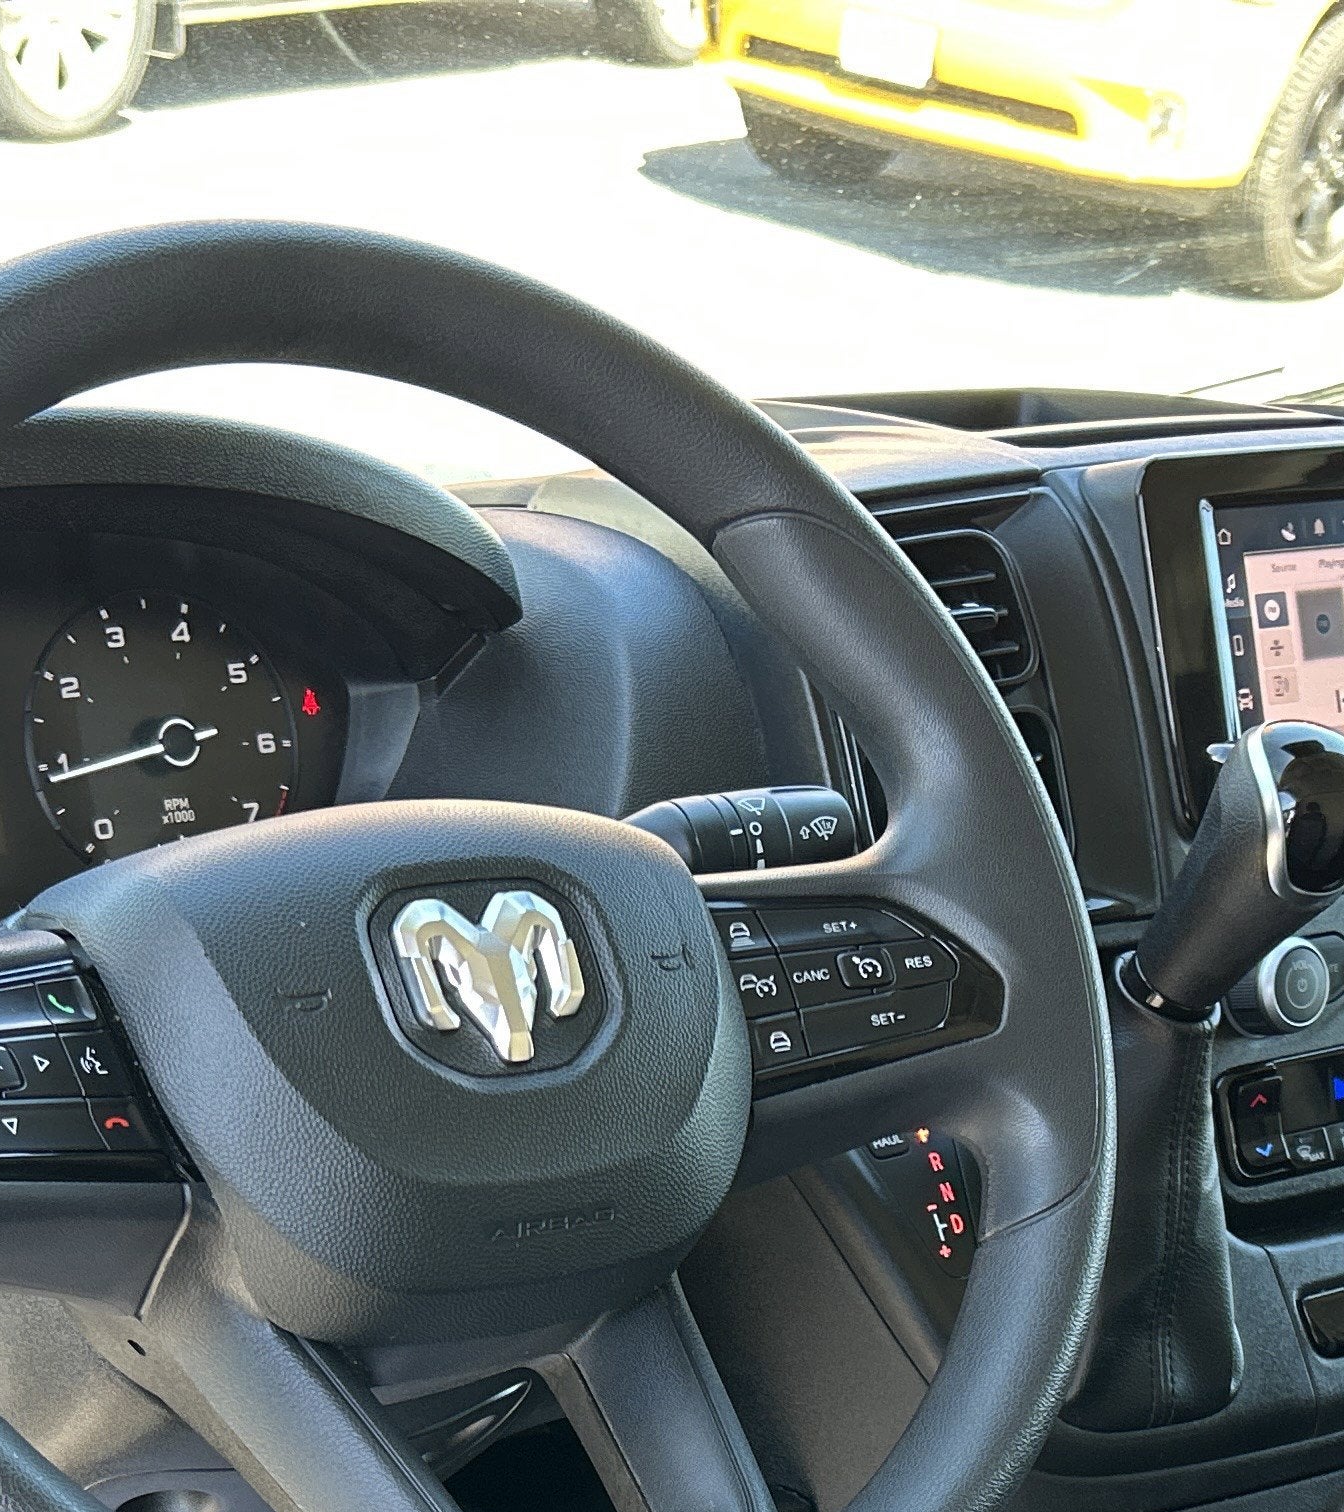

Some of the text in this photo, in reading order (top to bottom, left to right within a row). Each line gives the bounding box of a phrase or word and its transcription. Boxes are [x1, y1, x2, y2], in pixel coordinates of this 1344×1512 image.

[106, 626, 126, 648] 3
[171, 622, 190, 643] 4
[227, 662, 247, 684] 5
[59, 677, 80, 699] 2
[257, 733, 276, 754] 6
[57, 753, 69, 773] 1
[163, 797, 190, 811] RPM
[242, 802, 260, 823] 7
[162, 809, 195, 825] x1000
[94, 818, 114, 839] 0
[823, 920, 858, 935] SET+
[904, 954, 933, 970] RES
[792, 967, 831, 985] CANC
[927, 1151, 944, 1172] R
[938, 1181, 955, 1203] N
[949, 1213, 964, 1234] D
